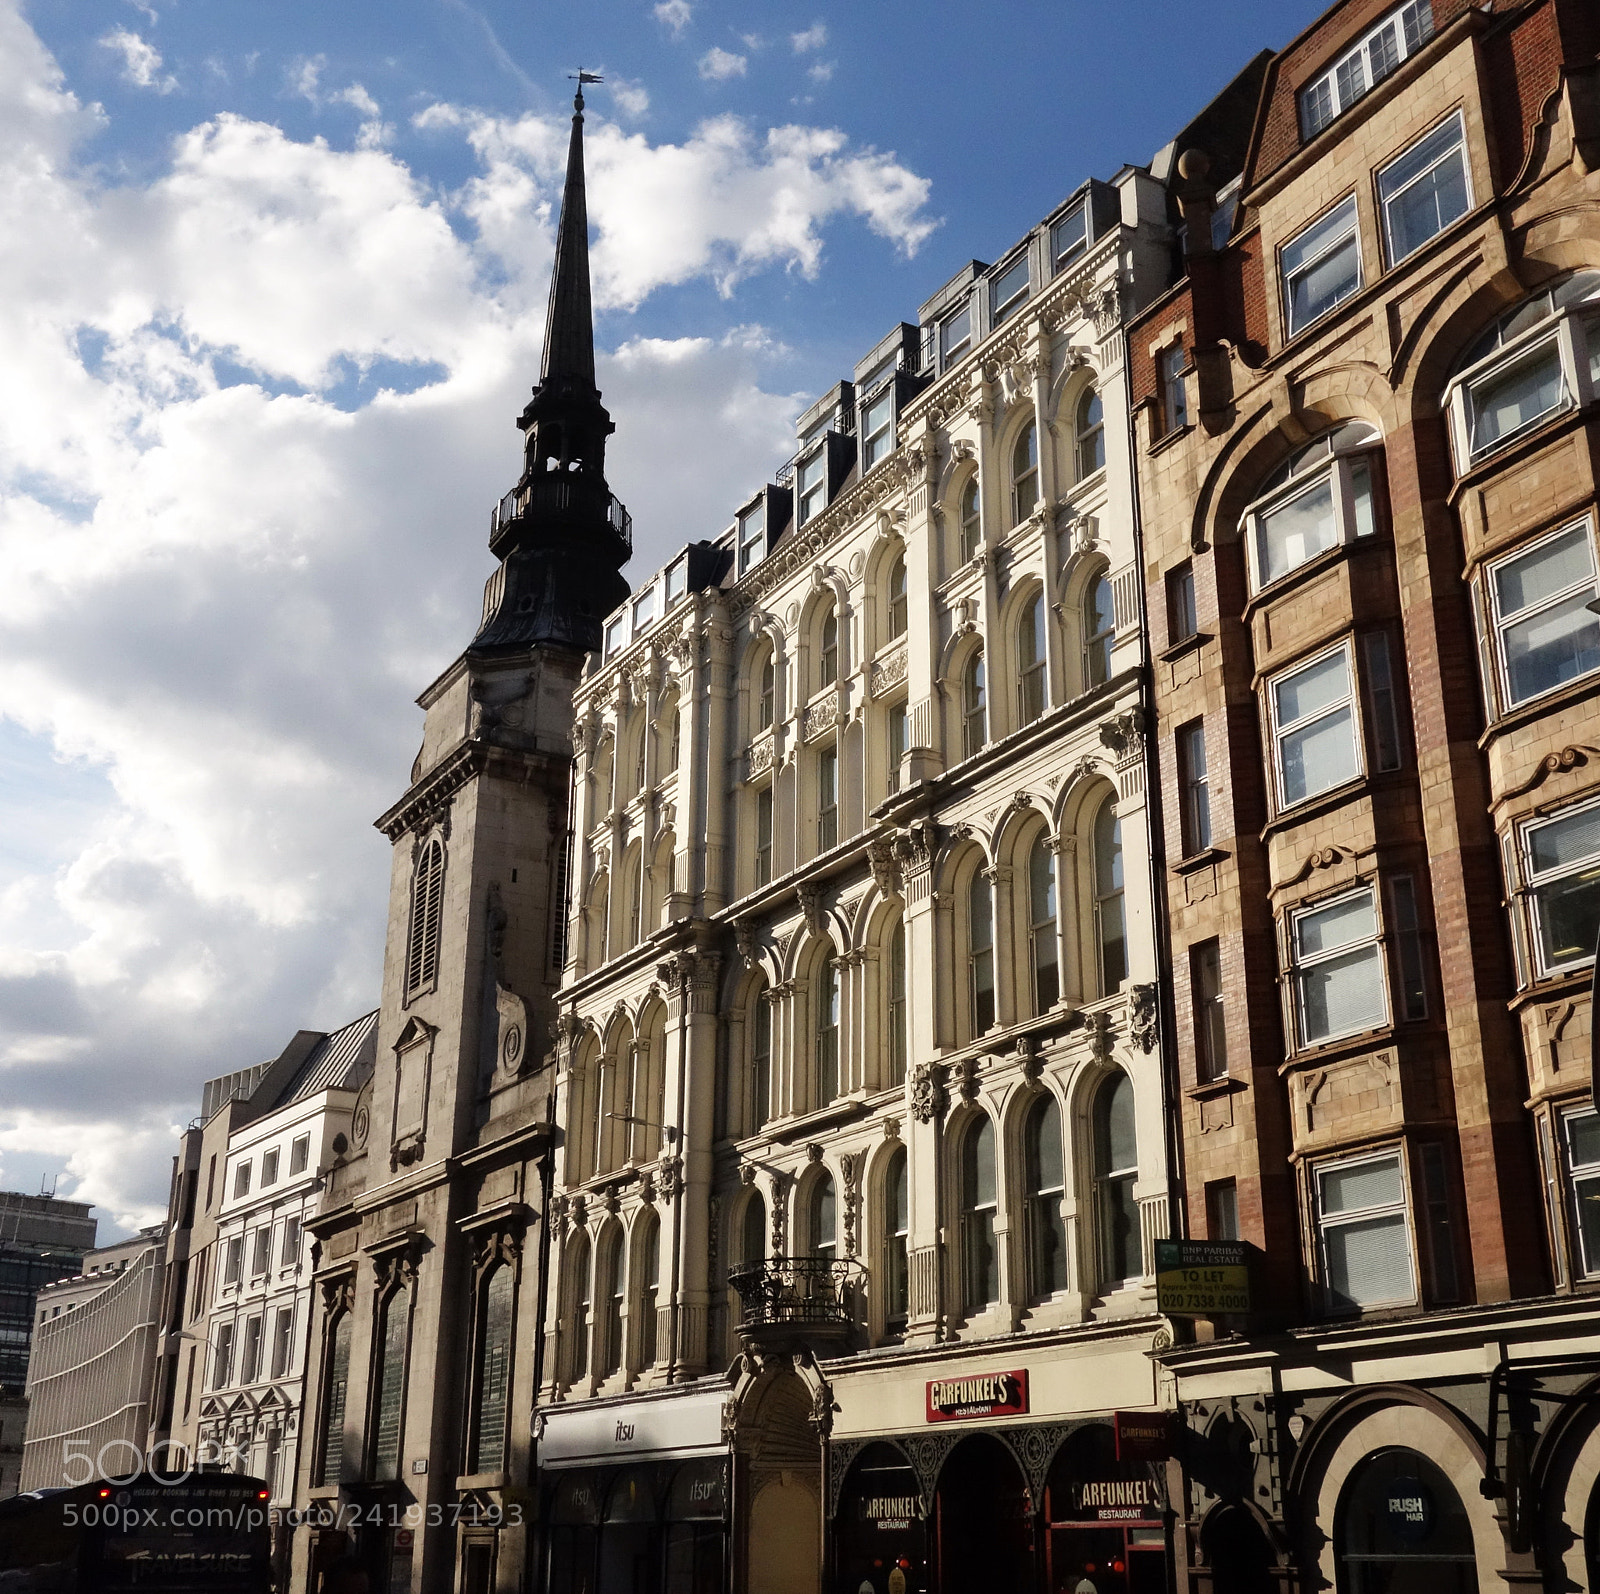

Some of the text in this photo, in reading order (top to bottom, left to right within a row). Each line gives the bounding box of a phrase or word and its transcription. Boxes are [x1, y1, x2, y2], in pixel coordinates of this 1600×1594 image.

[1182, 1246, 1244, 1256] BNP PARIBAS
[1183, 1255, 1241, 1264] REAL ESTATE
[1181, 1270, 1225, 1283] TO LET
[1162, 1294, 1247, 1309] 020 7338 4000
[931, 1374, 1008, 1411] GARFUNKEL'S
[955, 1405, 993, 1416] RESTAURANT
[615, 1419, 635, 1441] itsu
[1120, 1426, 1166, 1440] GARFUNKEL'S
[571, 1487, 591, 1507] itsu
[690, 1479, 711, 1502] itsu
[858, 1495, 927, 1521] ARFUNKEL'S
[1389, 1497, 1423, 1513] RUSH
[1098, 1509, 1142, 1520] RESTAURANT
[1406, 1512, 1424, 1522] HAIR
[877, 1520, 910, 1530] RESTAURANT
